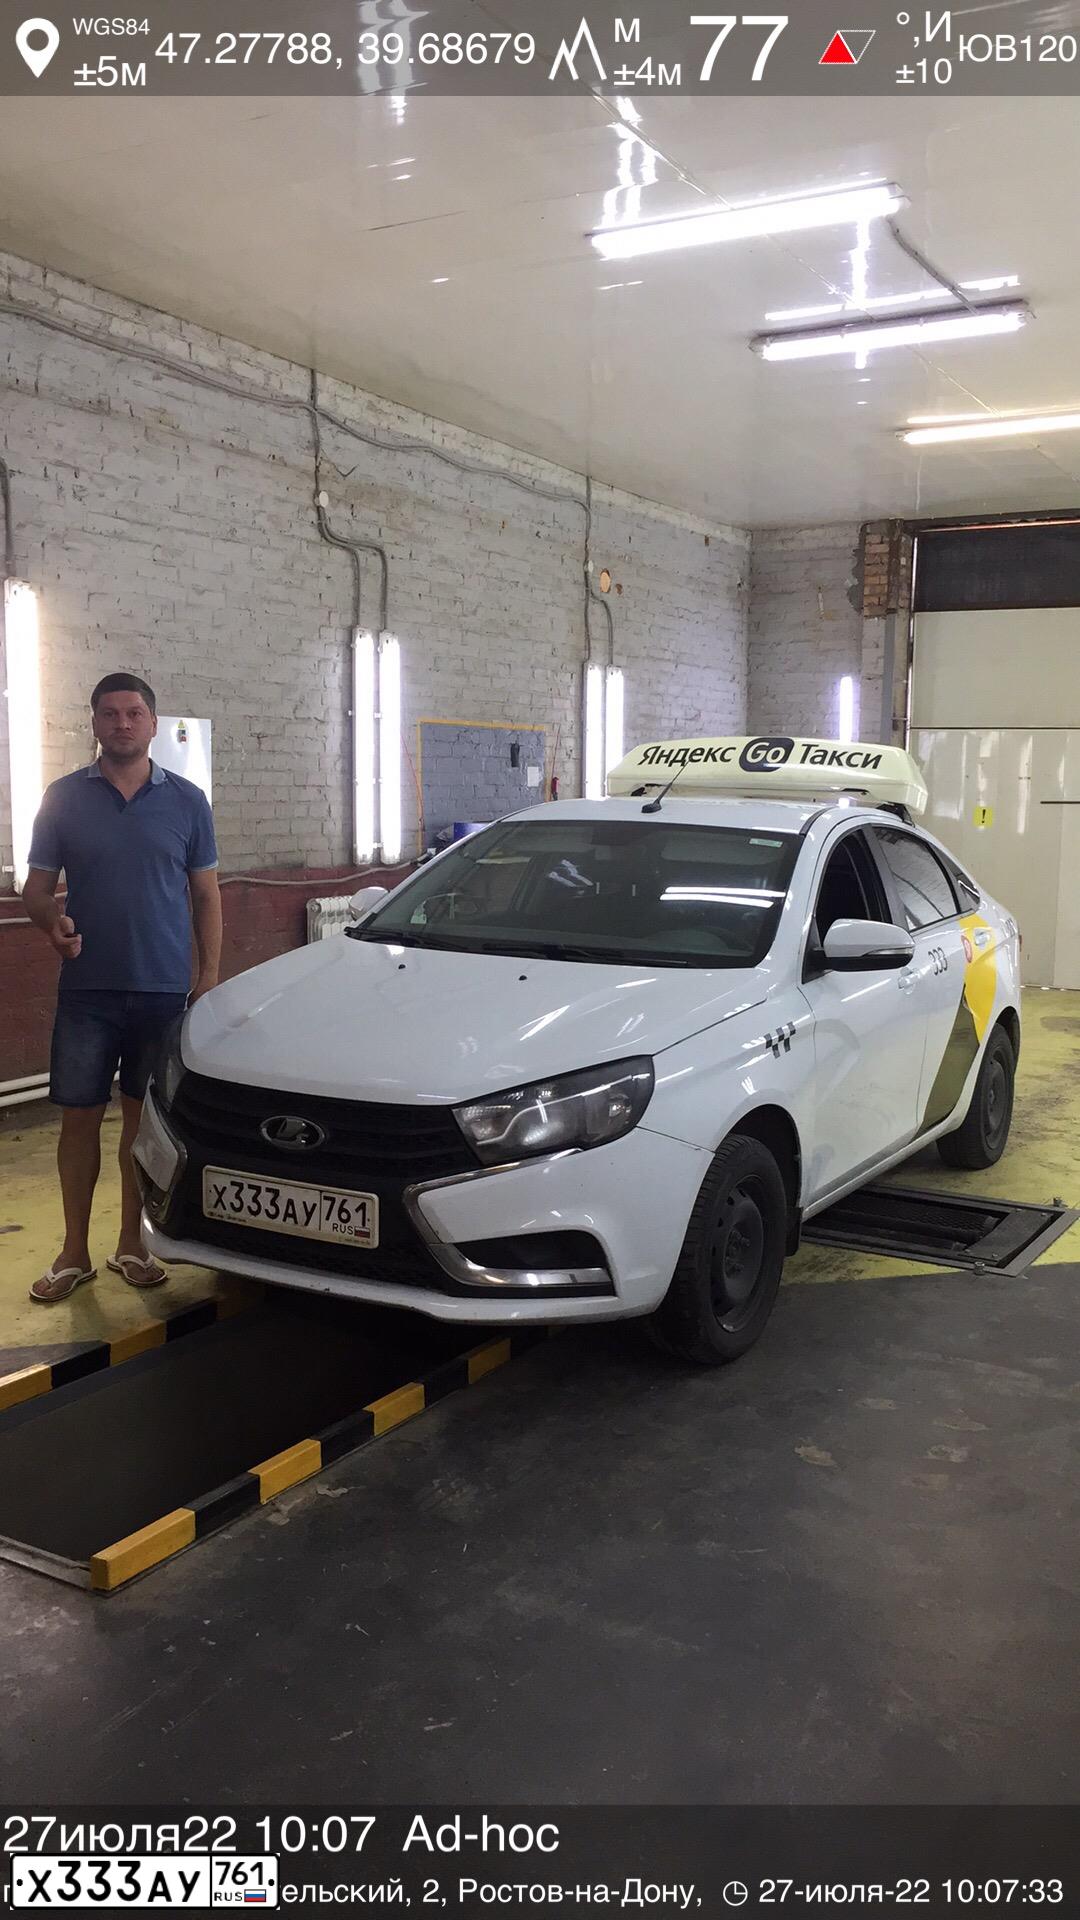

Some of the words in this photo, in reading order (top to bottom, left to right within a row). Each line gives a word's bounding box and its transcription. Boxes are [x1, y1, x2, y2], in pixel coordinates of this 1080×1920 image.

[638, 745, 737, 768] Яндекс
[744, 740, 788, 765] Go
[800, 743, 883, 770] Такси
[323, 1195, 368, 1227] 761
[332, 1222, 353, 1235] RUS
